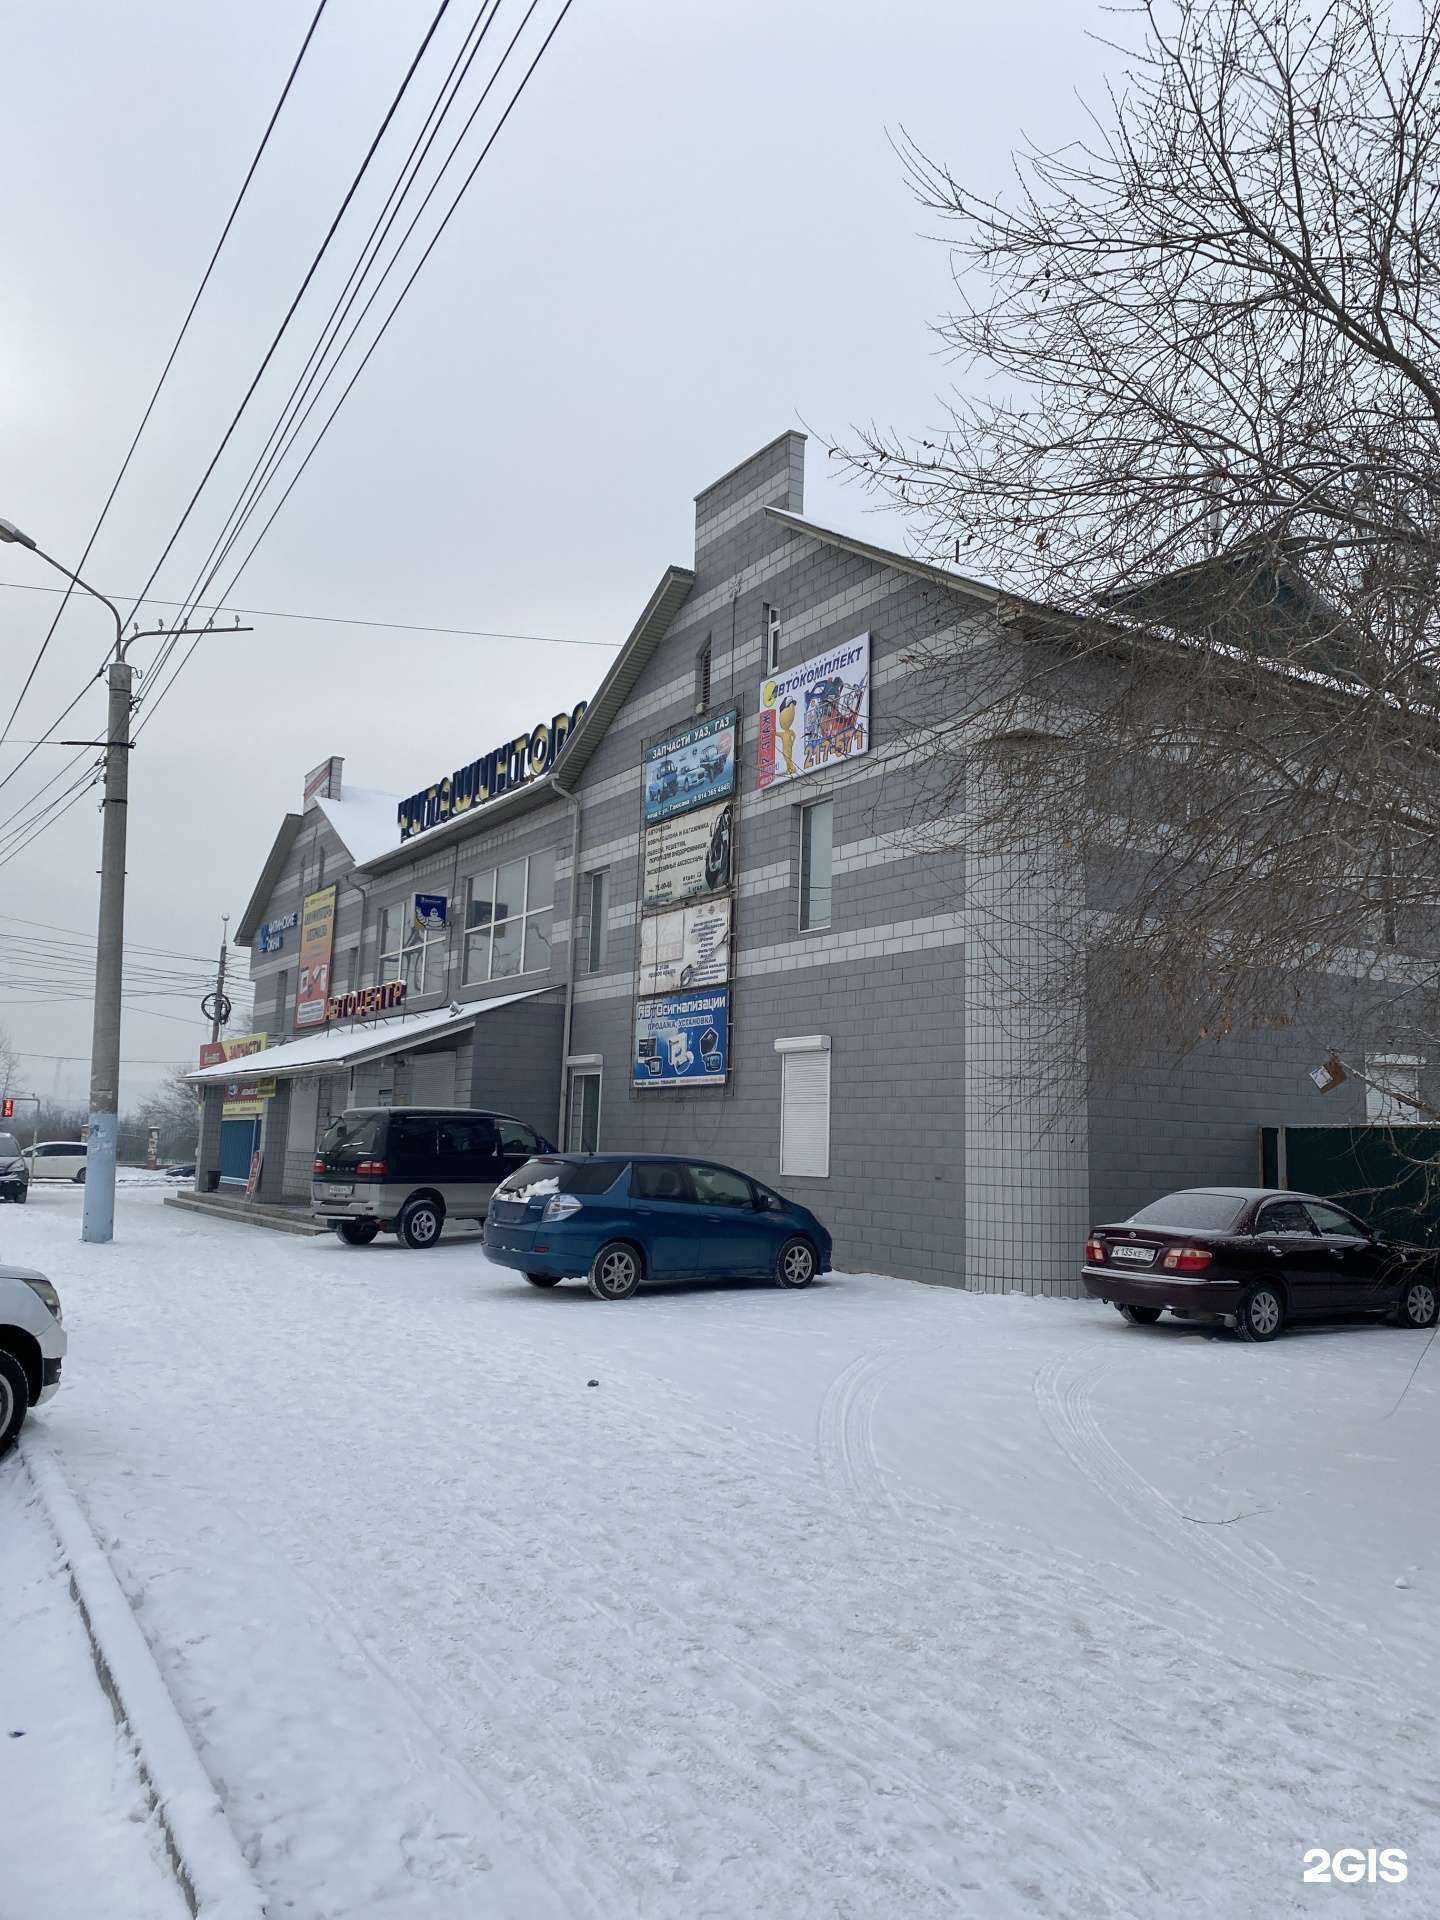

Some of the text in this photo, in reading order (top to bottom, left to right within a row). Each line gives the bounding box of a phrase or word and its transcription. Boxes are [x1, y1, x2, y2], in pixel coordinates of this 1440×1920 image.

[768, 646, 863, 700] АВТОКОМПЛЕКТ
[652, 716, 730, 759] ЗАПЧАСТИ УАЗ, ГАЗ
